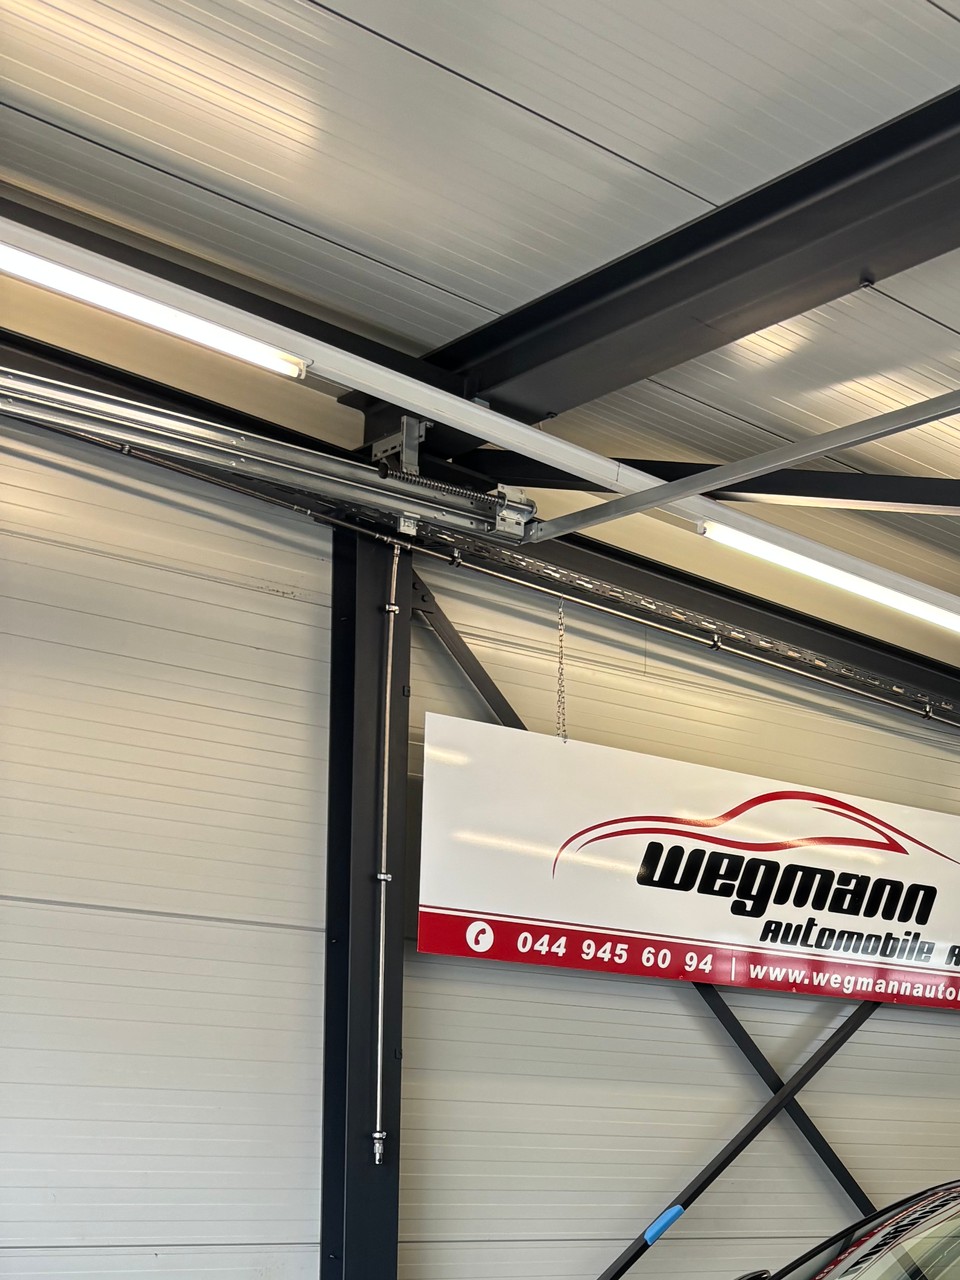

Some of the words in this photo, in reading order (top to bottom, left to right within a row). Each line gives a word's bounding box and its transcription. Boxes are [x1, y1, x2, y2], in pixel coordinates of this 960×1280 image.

[637, 842, 938, 925] wegmann
[516, 931, 567, 957] 044
[581, 939, 629, 964] 945
[641, 947, 672, 969] 60
[684, 952, 713, 974] 94
